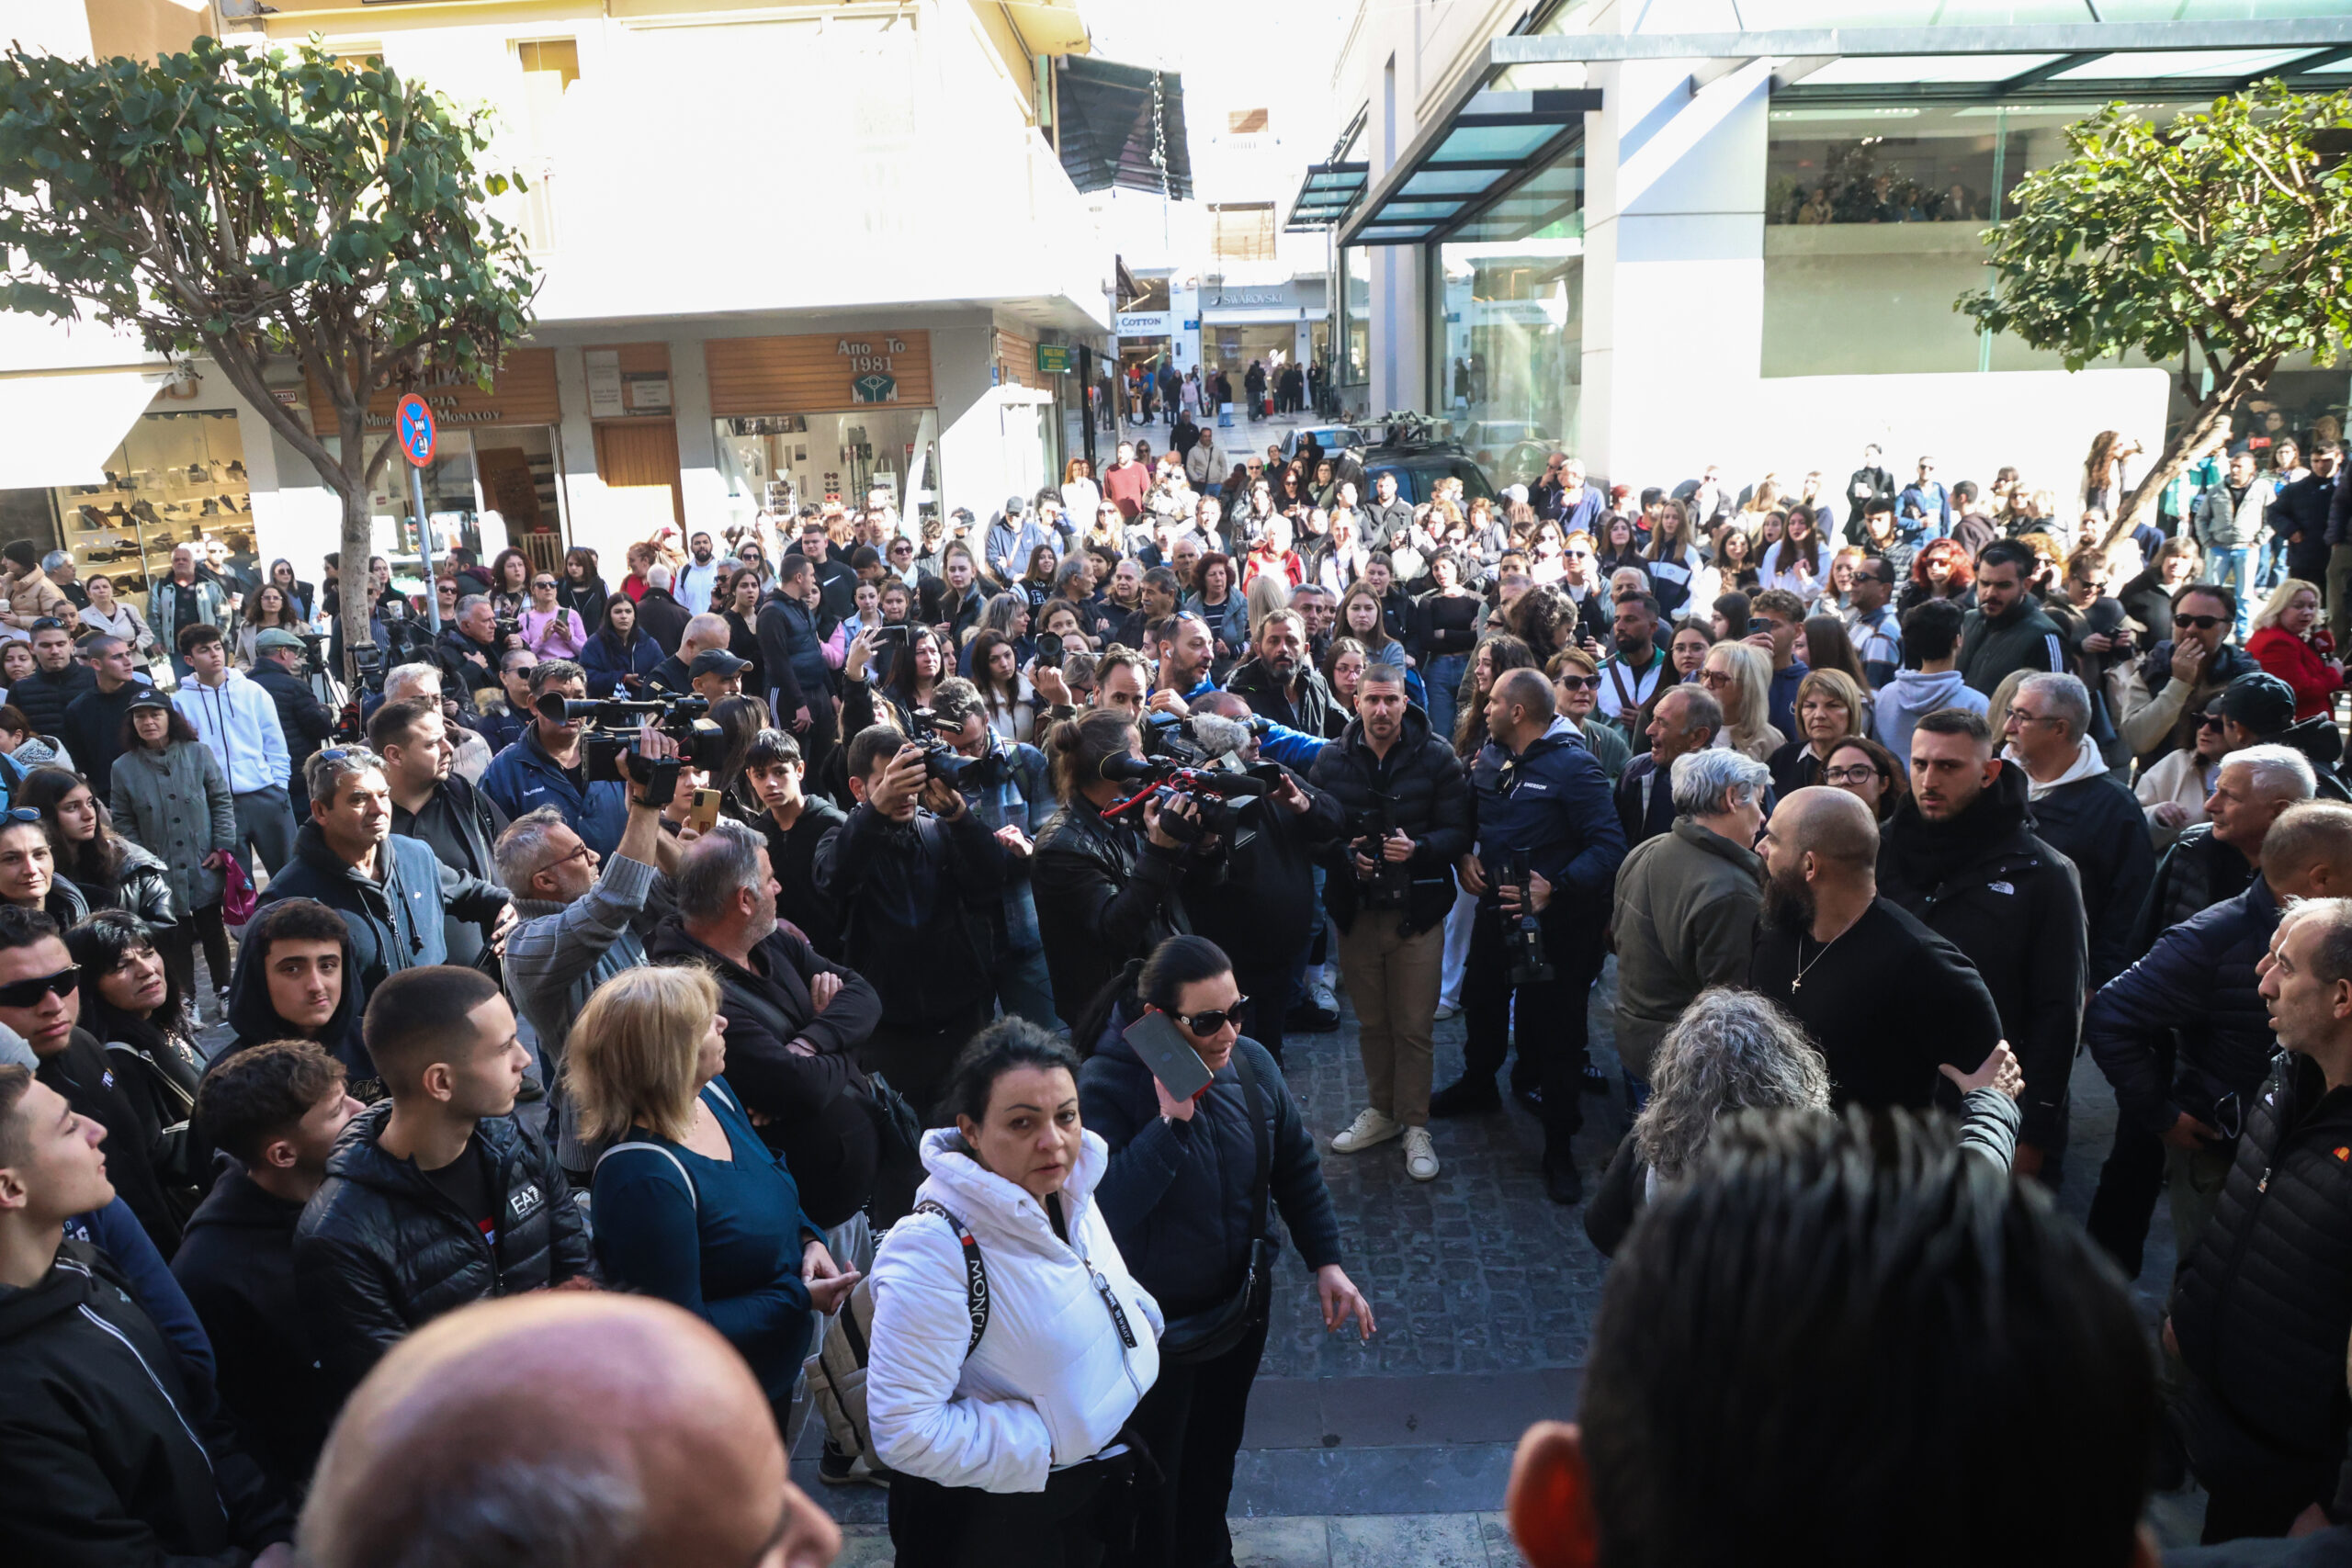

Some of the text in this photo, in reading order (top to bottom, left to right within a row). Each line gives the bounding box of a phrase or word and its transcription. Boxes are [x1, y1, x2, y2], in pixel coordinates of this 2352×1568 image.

[1224, 293, 1283, 304] SWAROVSKI
[1121, 317, 1161, 327] COTTON
[851, 355, 893, 372] 1981
[510, 1185, 539, 1214] EA7
[1117, 1317, 1131, 1338] WHAT
